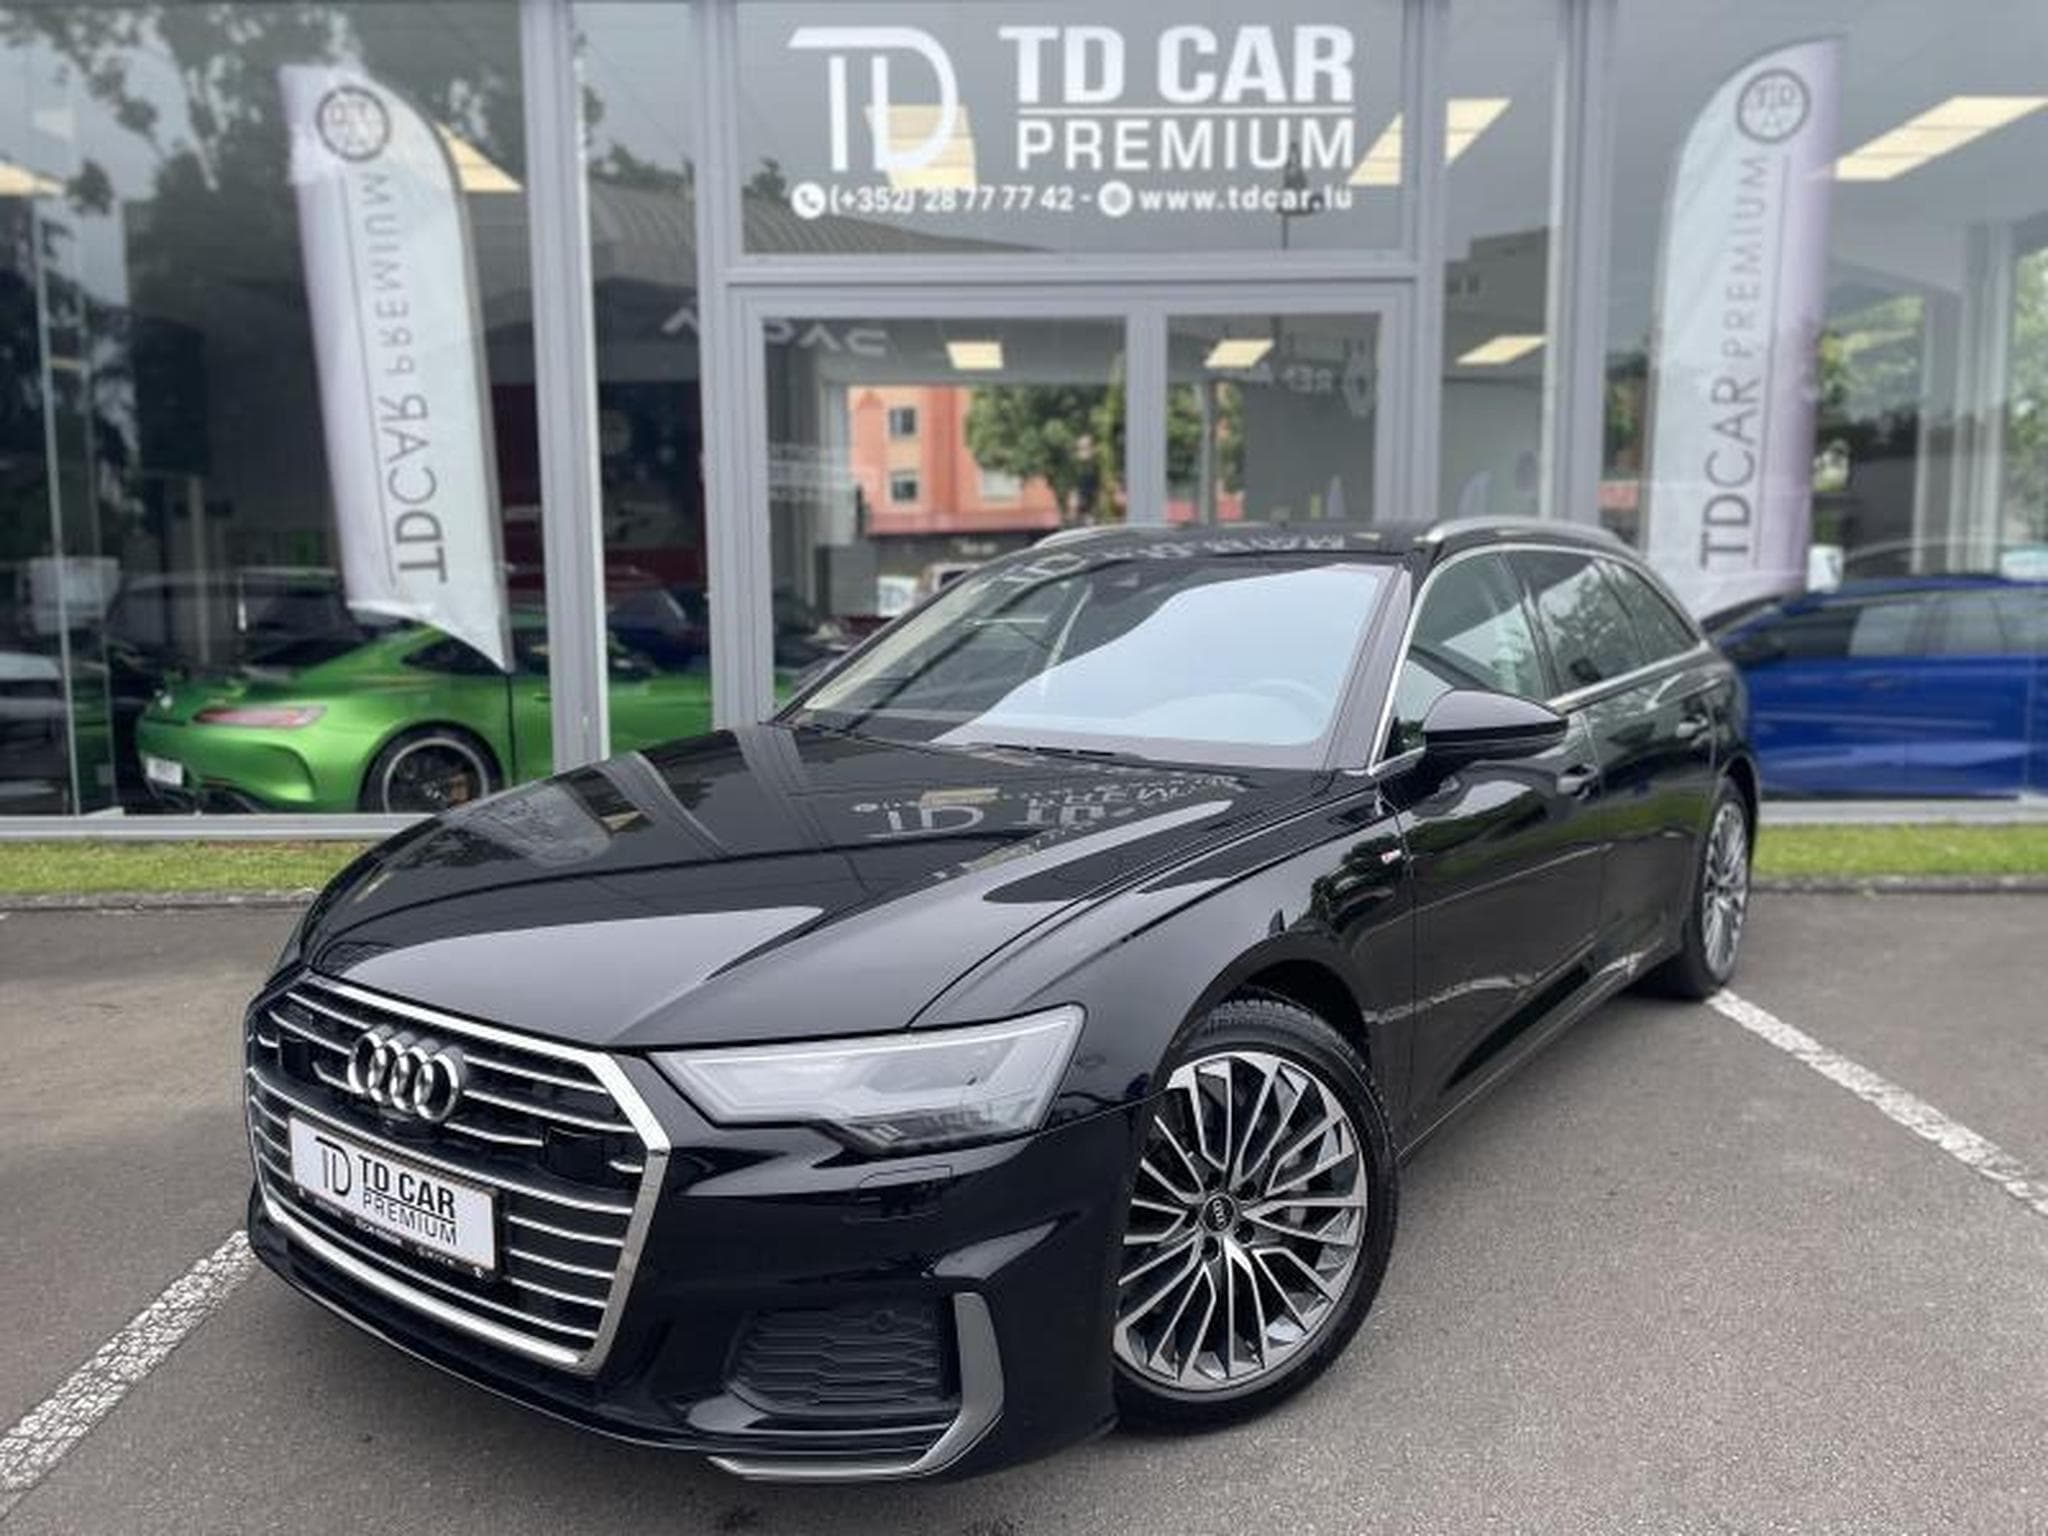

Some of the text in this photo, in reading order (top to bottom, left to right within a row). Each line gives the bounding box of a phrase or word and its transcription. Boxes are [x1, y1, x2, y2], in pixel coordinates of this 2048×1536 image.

[998, 25, 1354, 103] TD CAR
[1017, 118, 1354, 172] PREMIUM
[830, 184, 915, 215] (+352)
[922, 186, 957, 213] 28
[963, 185, 996, 212] 77
[1003, 185, 1034, 212] 77
[1041, 185, 1074, 212] 42
[1138, 184, 1352, 213] www.tdcar.lu
[1699, 155, 1768, 570] TDCAR PREMIUM
[357, 1153, 456, 1220] TD CAR
[362, 1191, 458, 1247] PREMIUM
